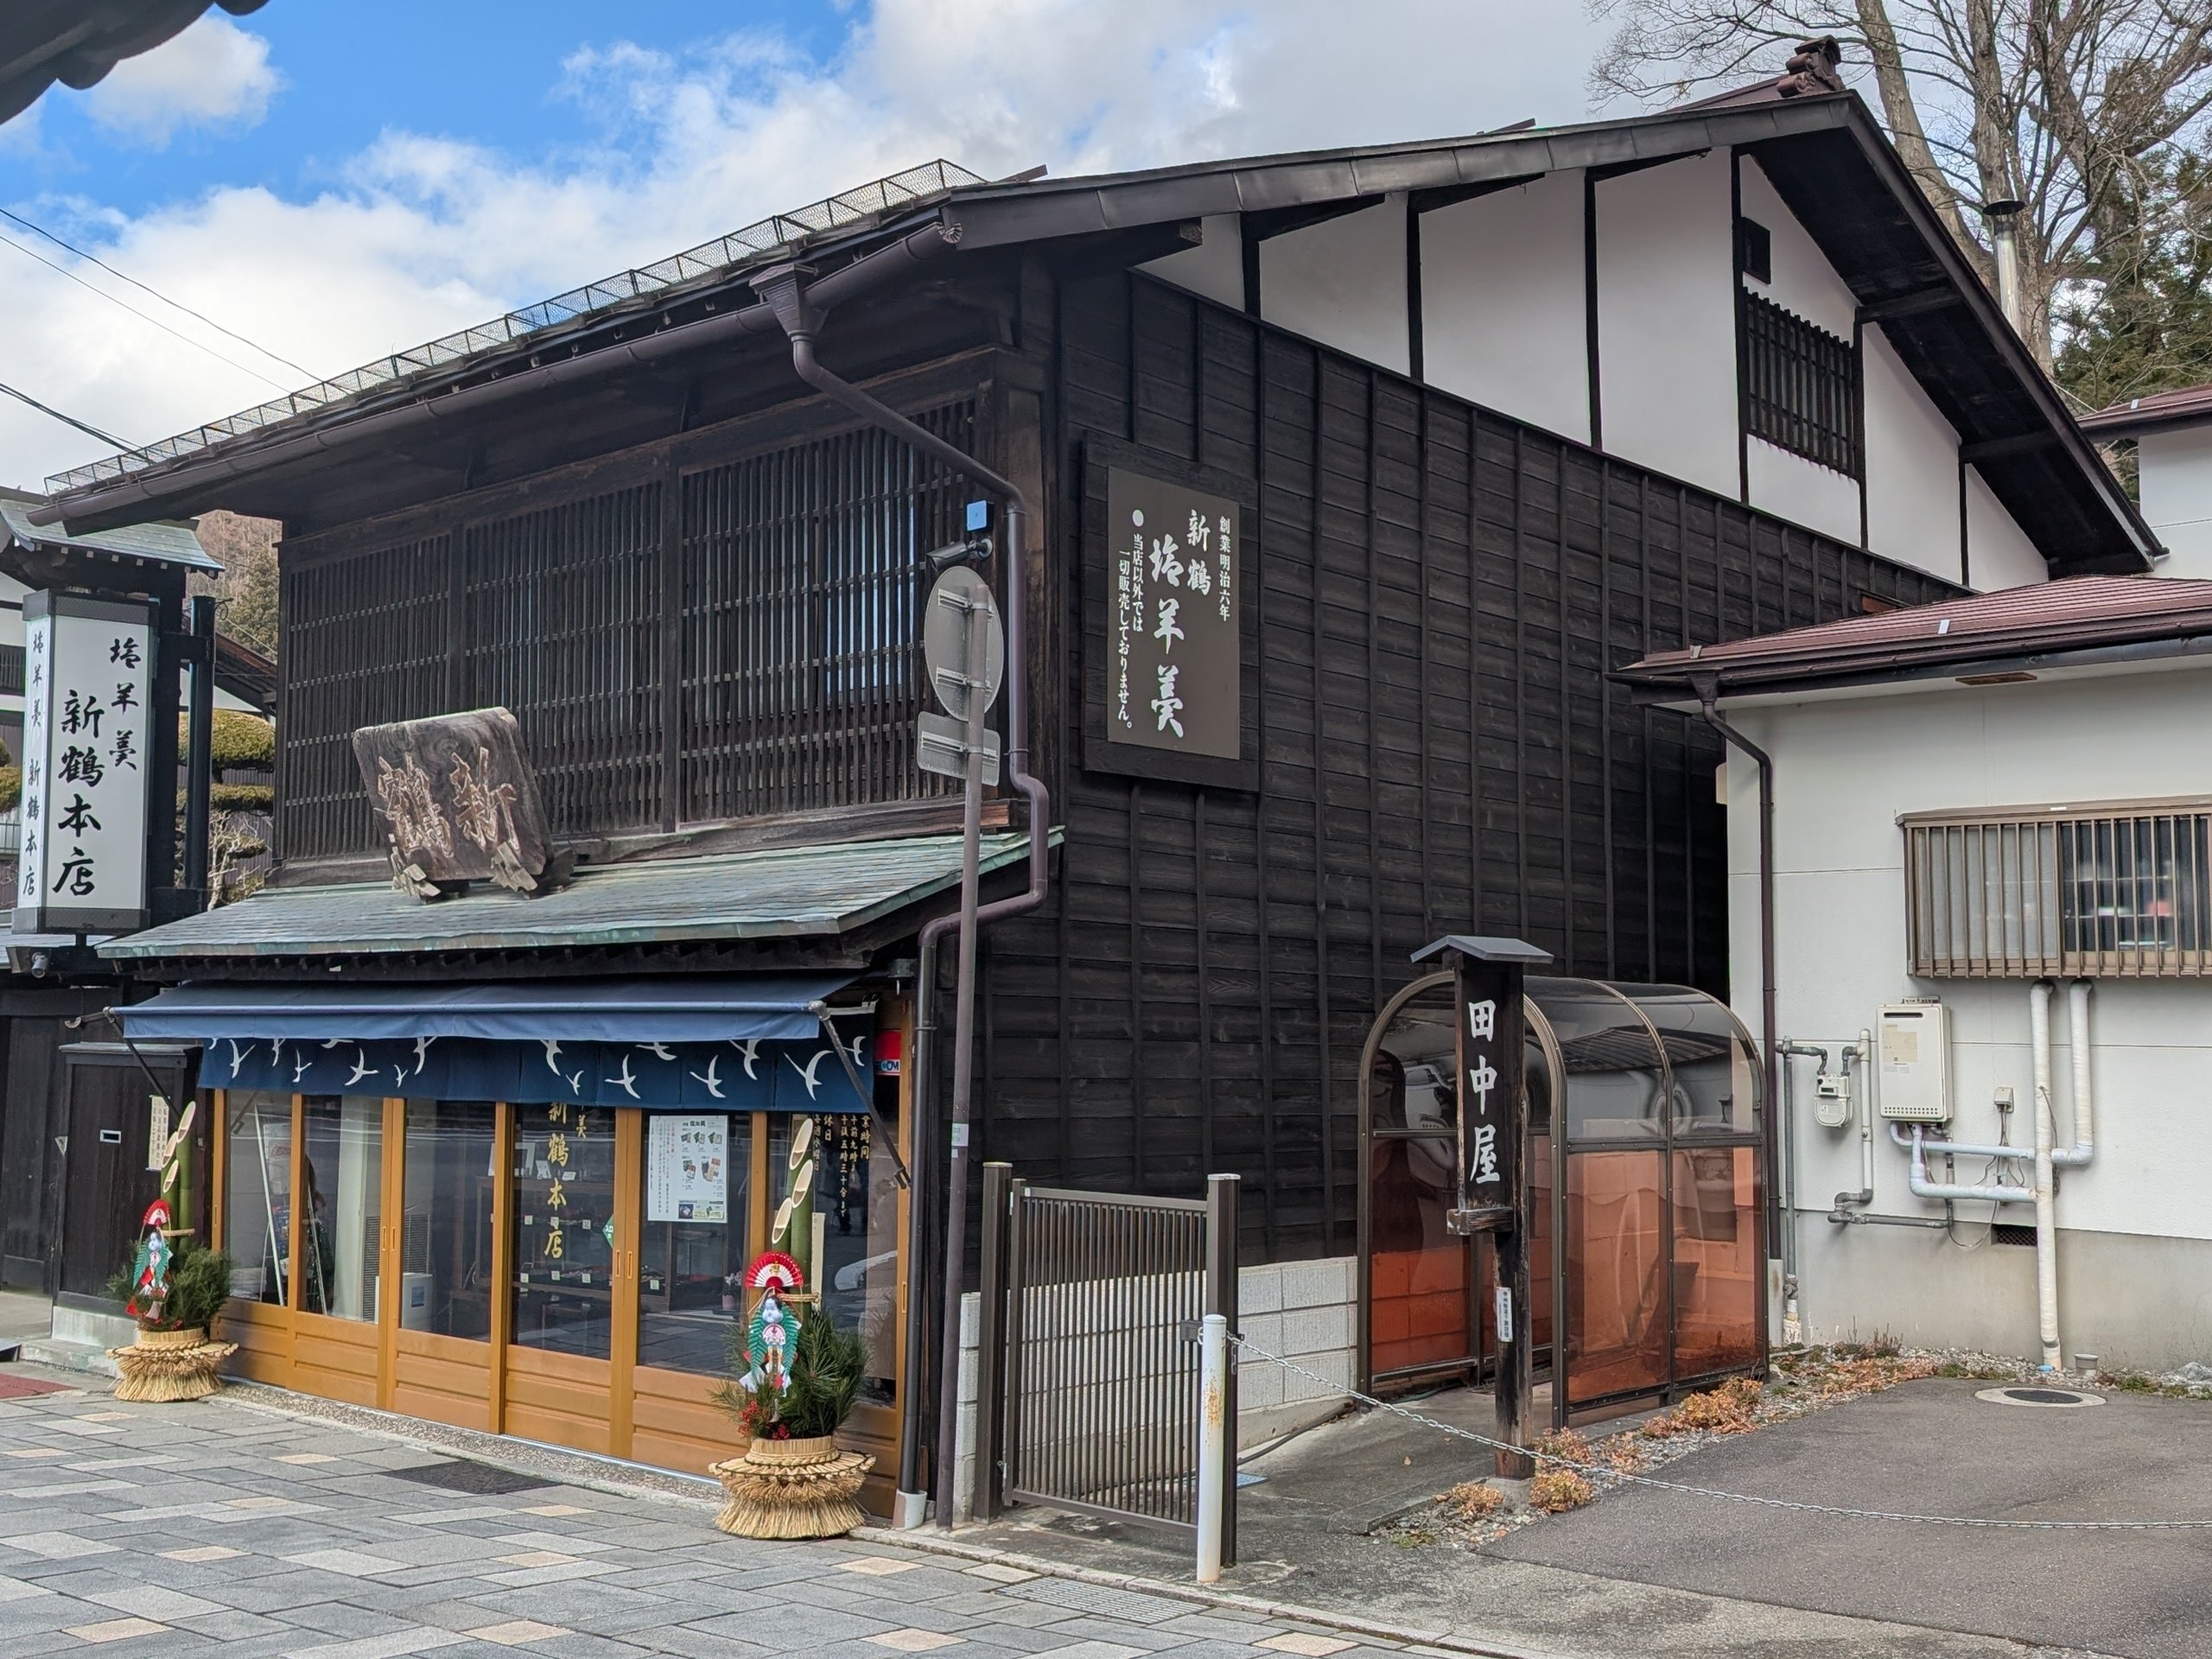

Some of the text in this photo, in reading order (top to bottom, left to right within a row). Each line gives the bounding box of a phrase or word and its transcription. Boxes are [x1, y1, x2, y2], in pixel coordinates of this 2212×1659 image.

[1118, 550, 1133, 729] 一切販売しておりません。
[1132, 533, 1144, 632] 当店以外では
[1149, 534, 1185, 738] 塩羊羹
[1186, 509, 1211, 596] 新鶴
[1219, 516, 1230, 621] 創業明治六年
[22, 632, 44, 896] 塩羊羹 新鶴本店
[52, 689, 105, 896] 新鶴本店
[110, 637, 142, 771] 塩羊羹
[1468, 999, 1500, 1185] 田中屋
